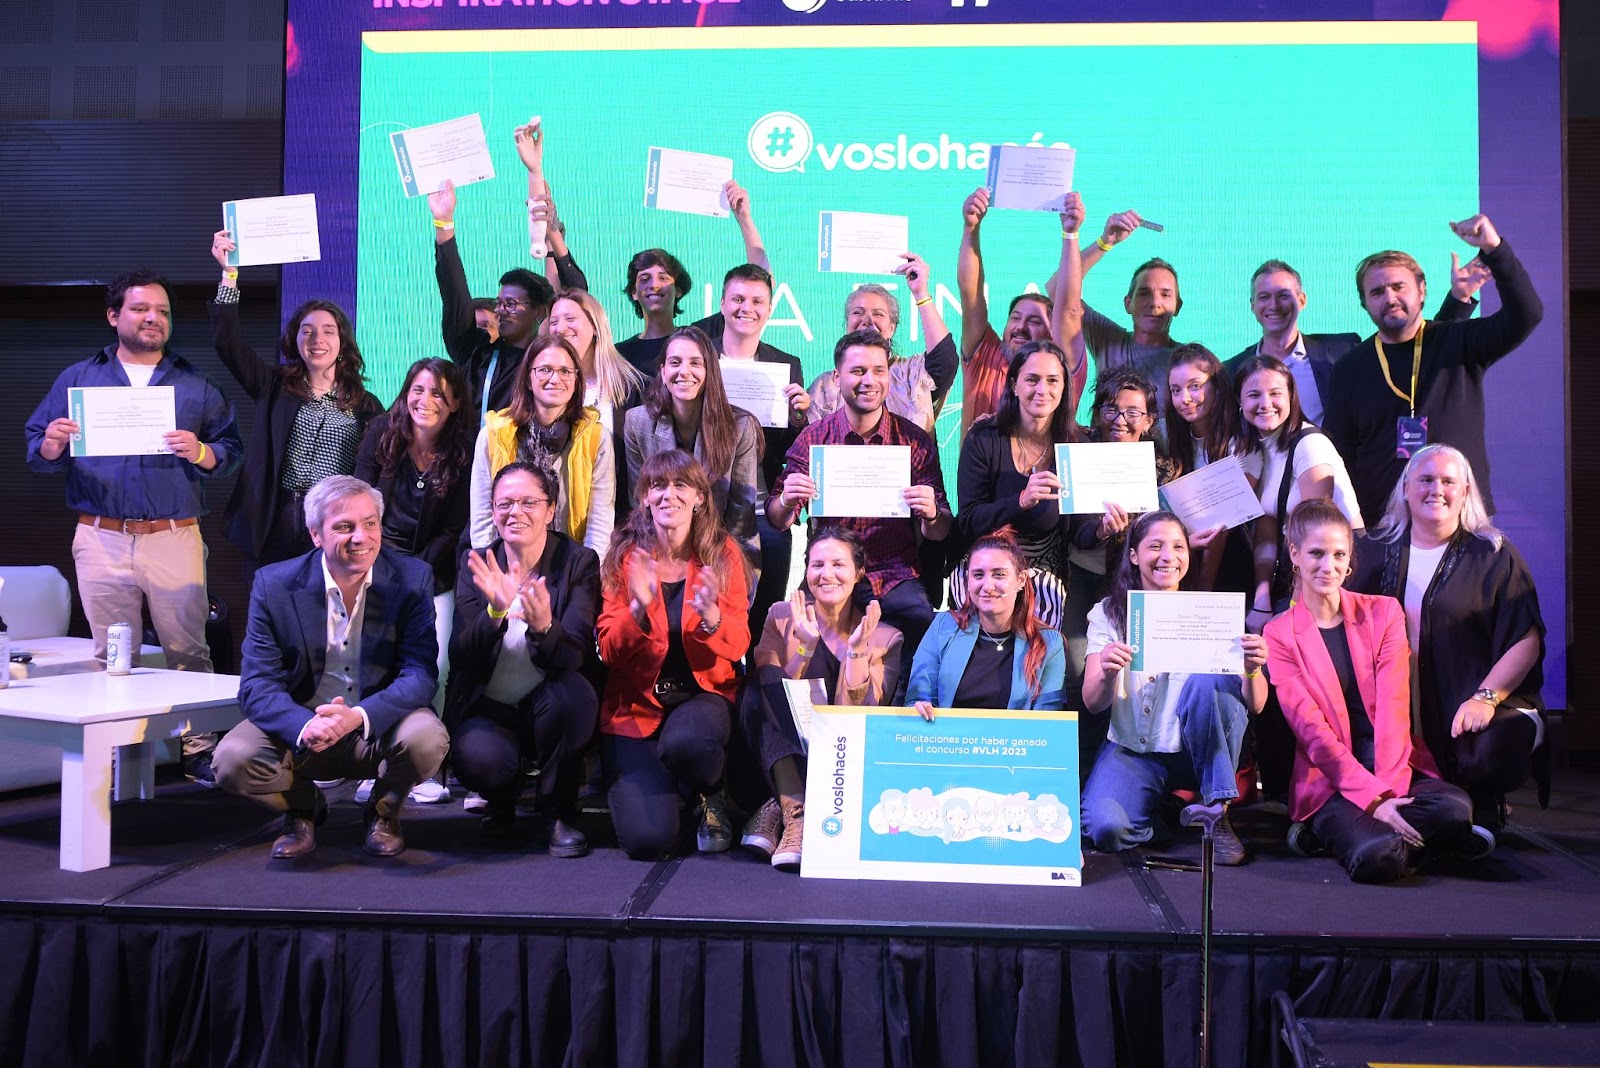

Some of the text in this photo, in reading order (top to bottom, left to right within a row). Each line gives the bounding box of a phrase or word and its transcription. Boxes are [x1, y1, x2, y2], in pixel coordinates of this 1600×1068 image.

[815, 131, 1072, 171] vosloha
[895, 733, 1048, 749] Felicitaciones por haber ganado
[914, 745, 1027, 756] el concurso #VLH 2023
[831, 735, 847, 815] voslohacés
[1051, 872, 1066, 881] BA
